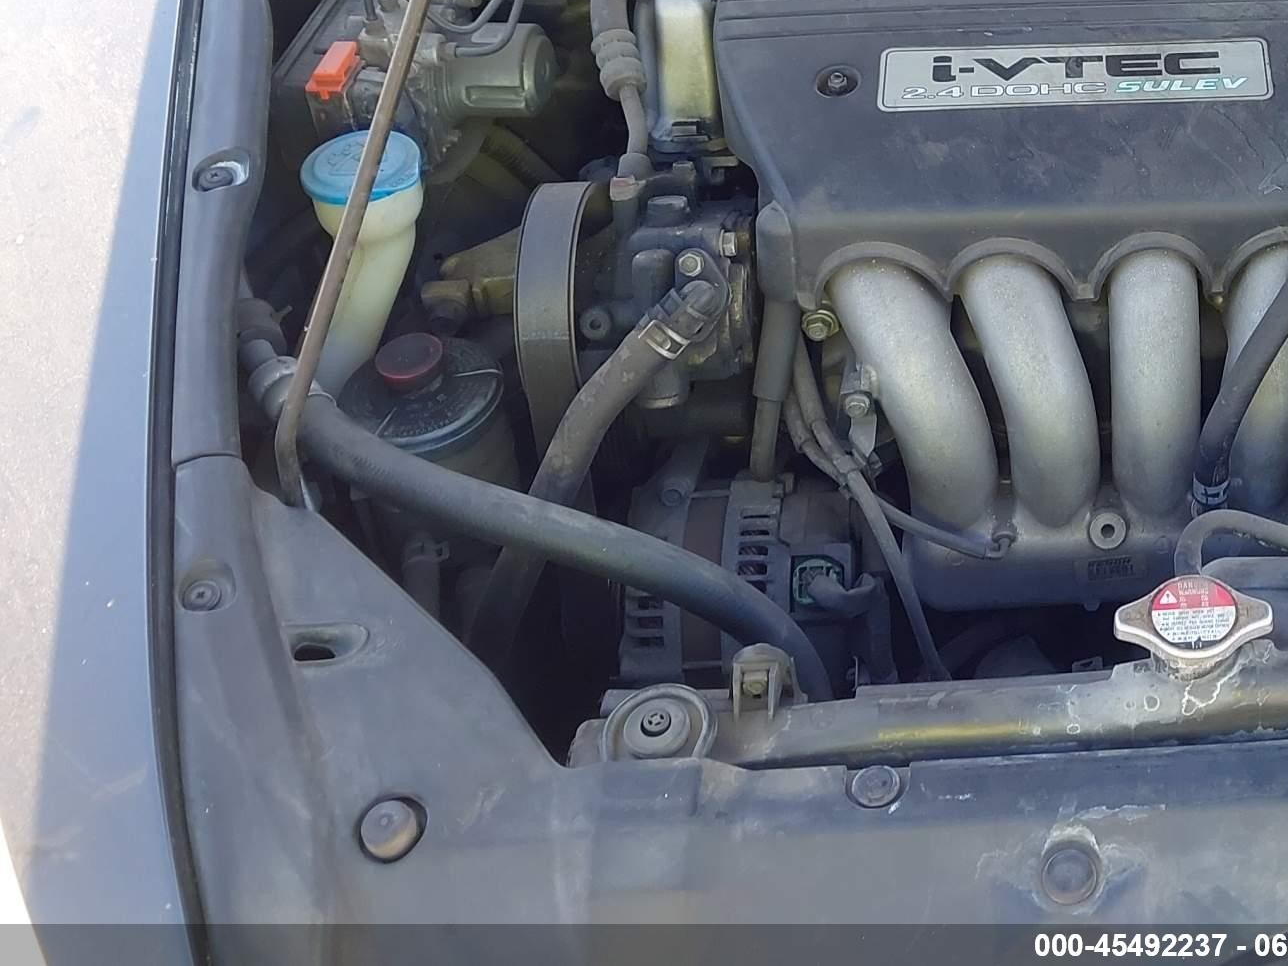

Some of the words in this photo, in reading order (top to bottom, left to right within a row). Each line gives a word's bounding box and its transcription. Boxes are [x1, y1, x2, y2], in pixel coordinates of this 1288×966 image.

[932, 51, 1222, 83] i-VTEC
[901, 85, 964, 100] 2.4
[970, 81, 1107, 98] DOHC
[1115, 77, 1249, 93] SULEV
